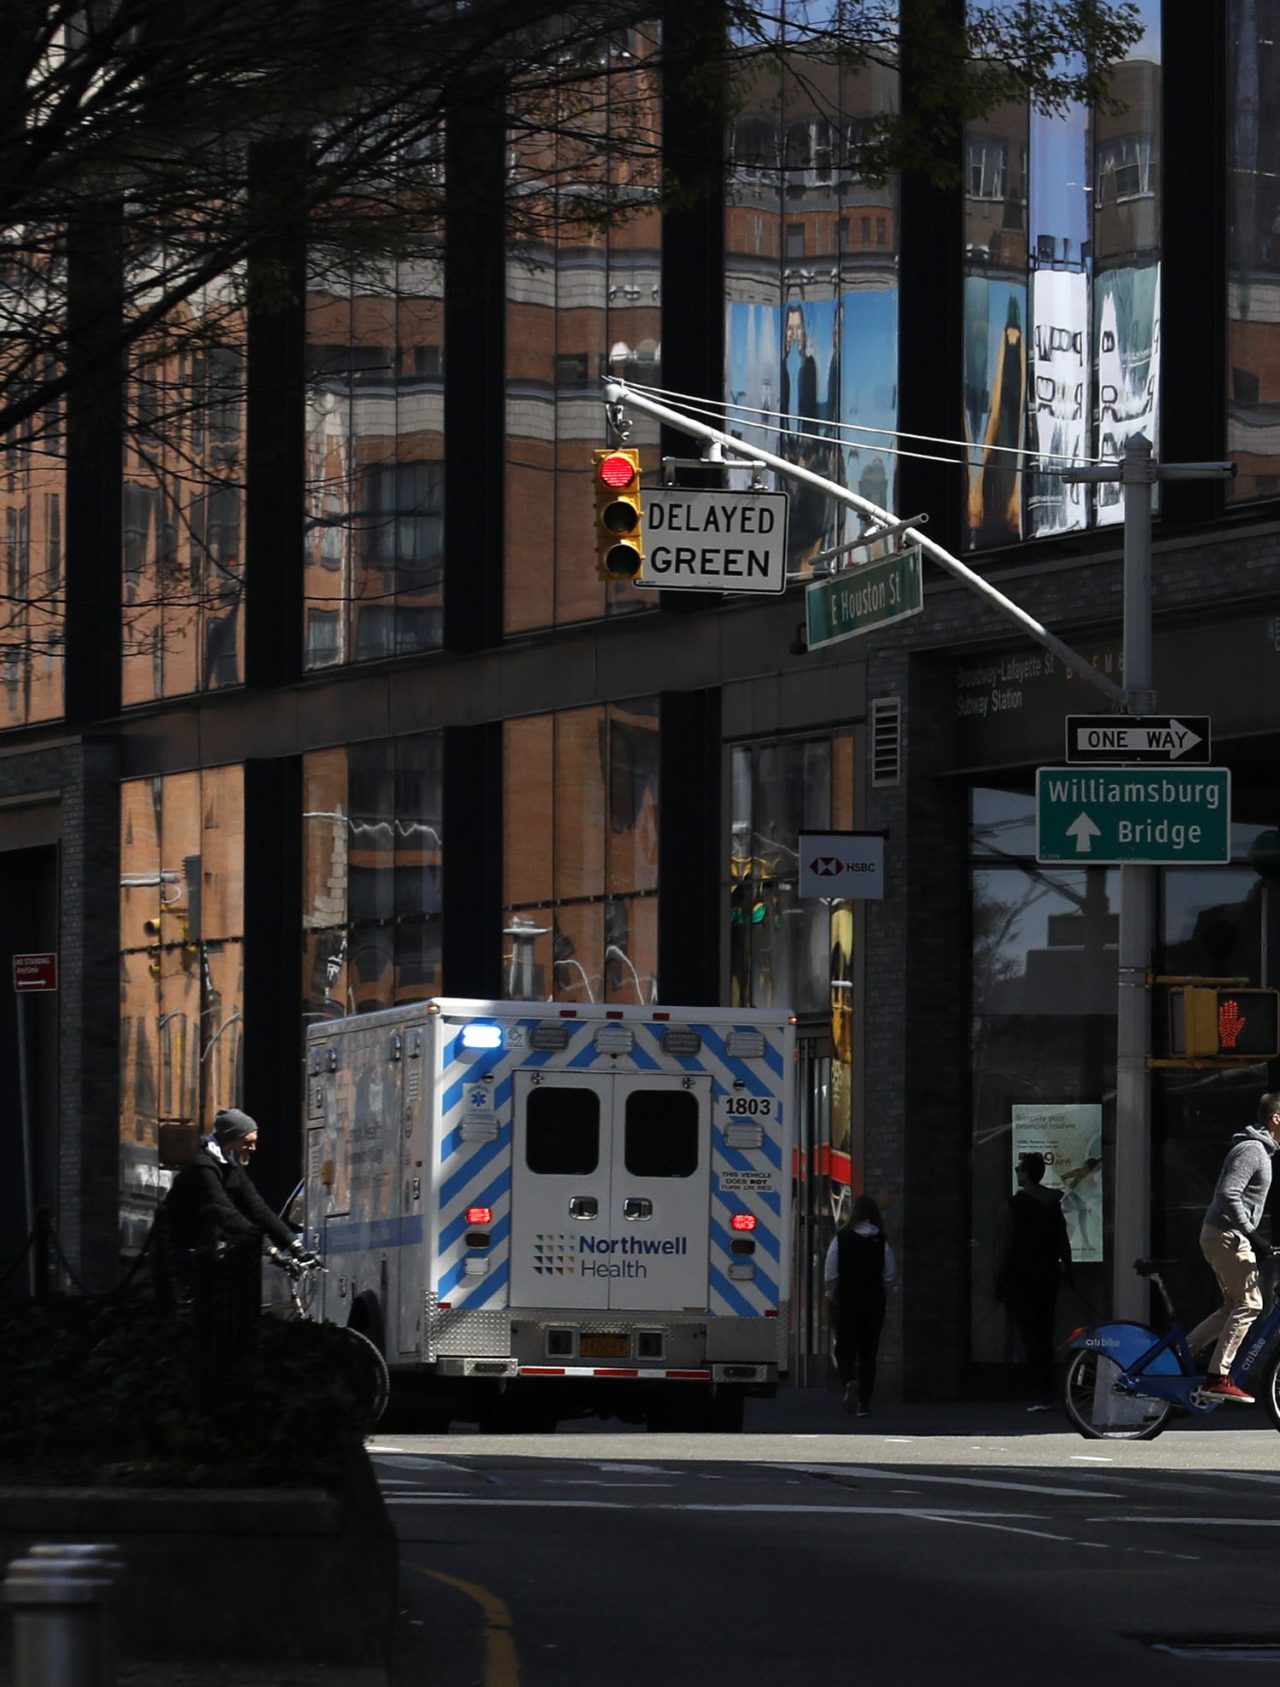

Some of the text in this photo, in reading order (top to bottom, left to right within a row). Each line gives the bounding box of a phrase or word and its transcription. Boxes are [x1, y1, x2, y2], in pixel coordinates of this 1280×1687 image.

[648, 502, 775, 534] DELAYED
[650, 546, 770, 578] GREEN
[831, 570, 901, 626] E Houston St
[1044, 651, 1054, 675] St
[991, 688, 1023, 712] Station
[1087, 730, 1188, 749] ONE WAY
[1048, 778, 1220, 809] Williamsburg
[1118, 818, 1202, 850] Bridge
[846, 862, 876, 873] HSBC
[725, 1097, 771, 1115] 1803
[579, 1236, 687, 1255] Northwell
[581, 1259, 647, 1278] Health
[1101, 1337, 1121, 1347] bike
